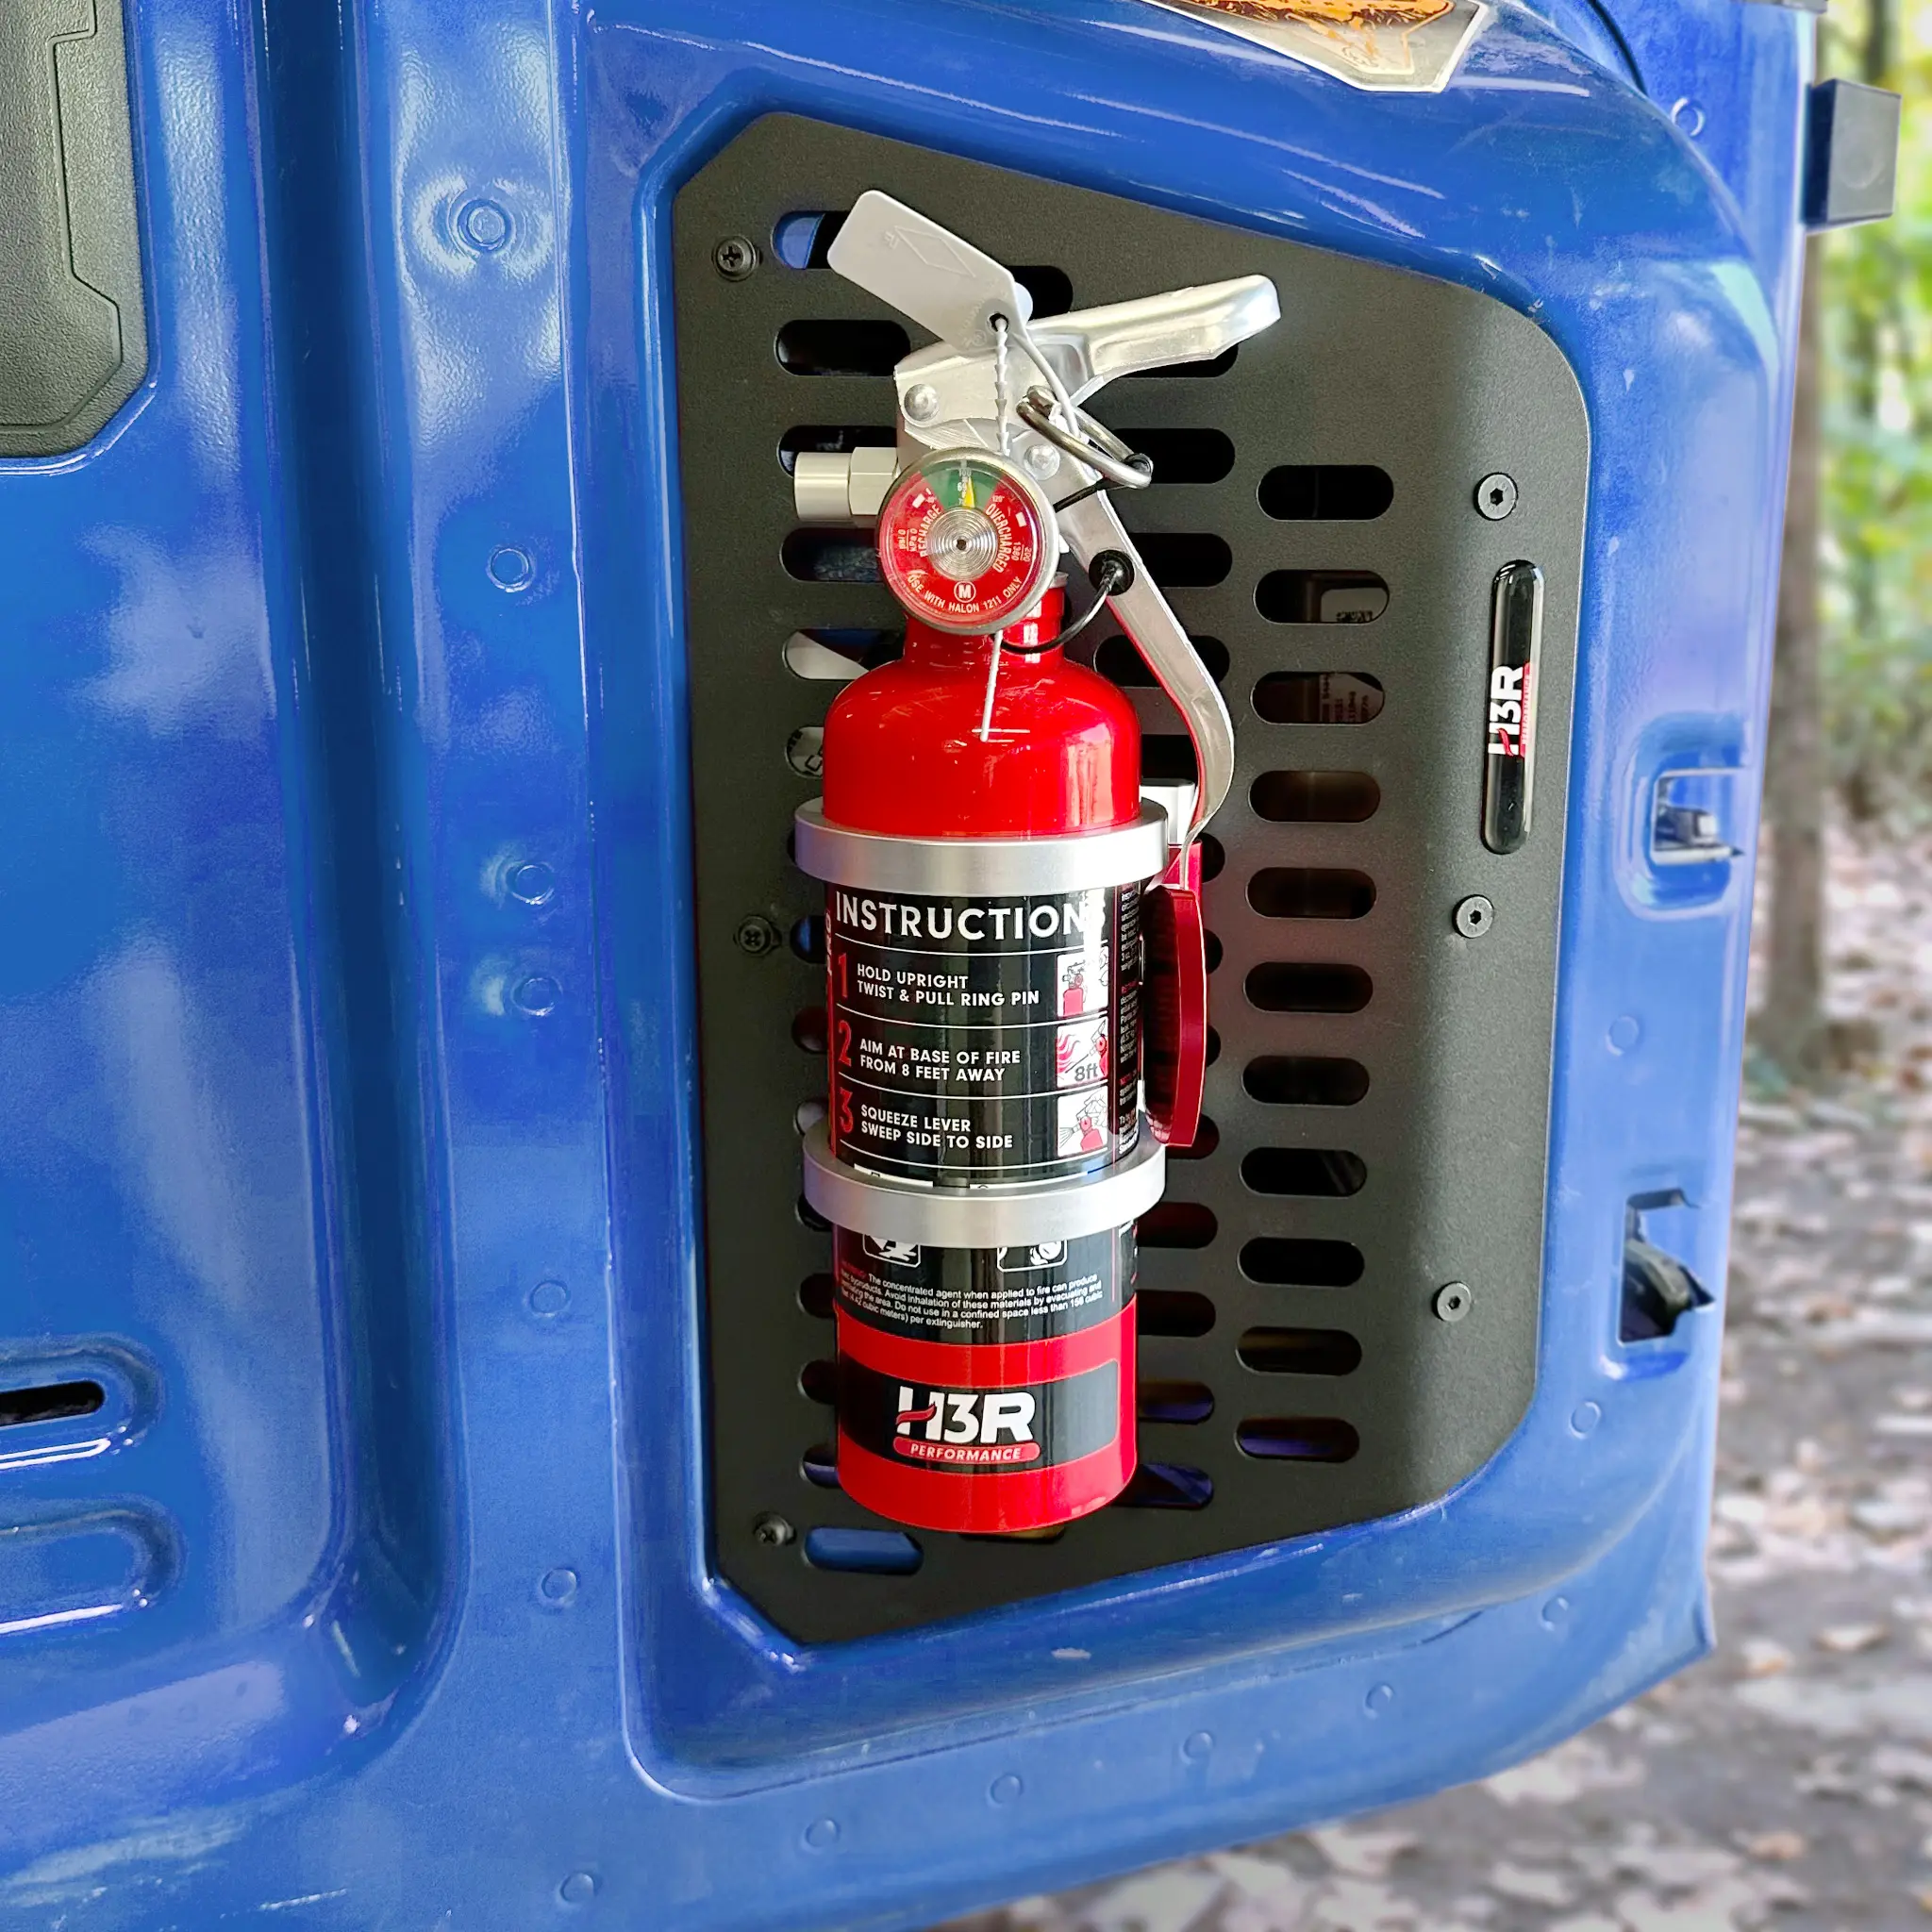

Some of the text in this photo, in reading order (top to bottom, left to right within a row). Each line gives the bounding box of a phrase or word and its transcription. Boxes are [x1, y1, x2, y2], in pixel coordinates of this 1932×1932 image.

[917, 504, 942, 558] RECHARGE
[985, 503, 1012, 574] OVERCHARGED
[908, 575, 1024, 613] USE WITH HALON 1211 ONLY
[1489, 665, 1524, 756] H3R
[838, 953, 848, 998] 1
[857, 963, 969, 989] HOLD UPRIGHT
[857, 980, 1040, 1007] TWIST & PULL RING PIN
[839, 1020, 852, 1067] 2
[859, 1038, 1021, 1064] AIM AT BASE OF FIRE
[859, 1055, 1006, 1081] FROM 8 FEET AWAY
[1074, 1062, 1099, 1082] 8ft
[839, 1087, 854, 1133] 3
[860, 1104, 971, 1132] SQUEEZE LEVER
[860, 1121, 1013, 1149] SWEEP SIDE TO SIDE
[868, 1273, 1098, 1301] The concentrated agent when applied to fire can produce
[884, 1289, 907, 1301] Avoid
[908, 1293, 950, 1307] inhalation
[951, 1299, 961, 1308] of
[962, 1300, 989, 1310] these
[991, 1298, 1032, 1309] materials
[1034, 1296, 1044, 1307] by
[1046, 1286, 1089, 1304] evacuating
[879, 1307, 909, 1323] meters)
[909, 1316, 924, 1324] per
[925, 1318, 984, 1330] extinguisher.
[894, 1301, 907, 1311] Do
[908, 1305, 922, 1314] not
[923, 1308, 940, 1318] use
[941, 1307, 950, 1318] in
[960, 1308, 1000, 1321] confined
[1002, 1308, 1029, 1320] space
[1031, 1305, 1049, 1316] less
[1050, 1301, 1069, 1313] than
[896, 1386, 1036, 1444] H3R
[909, 1443, 1022, 1461] PERFORMANCE
